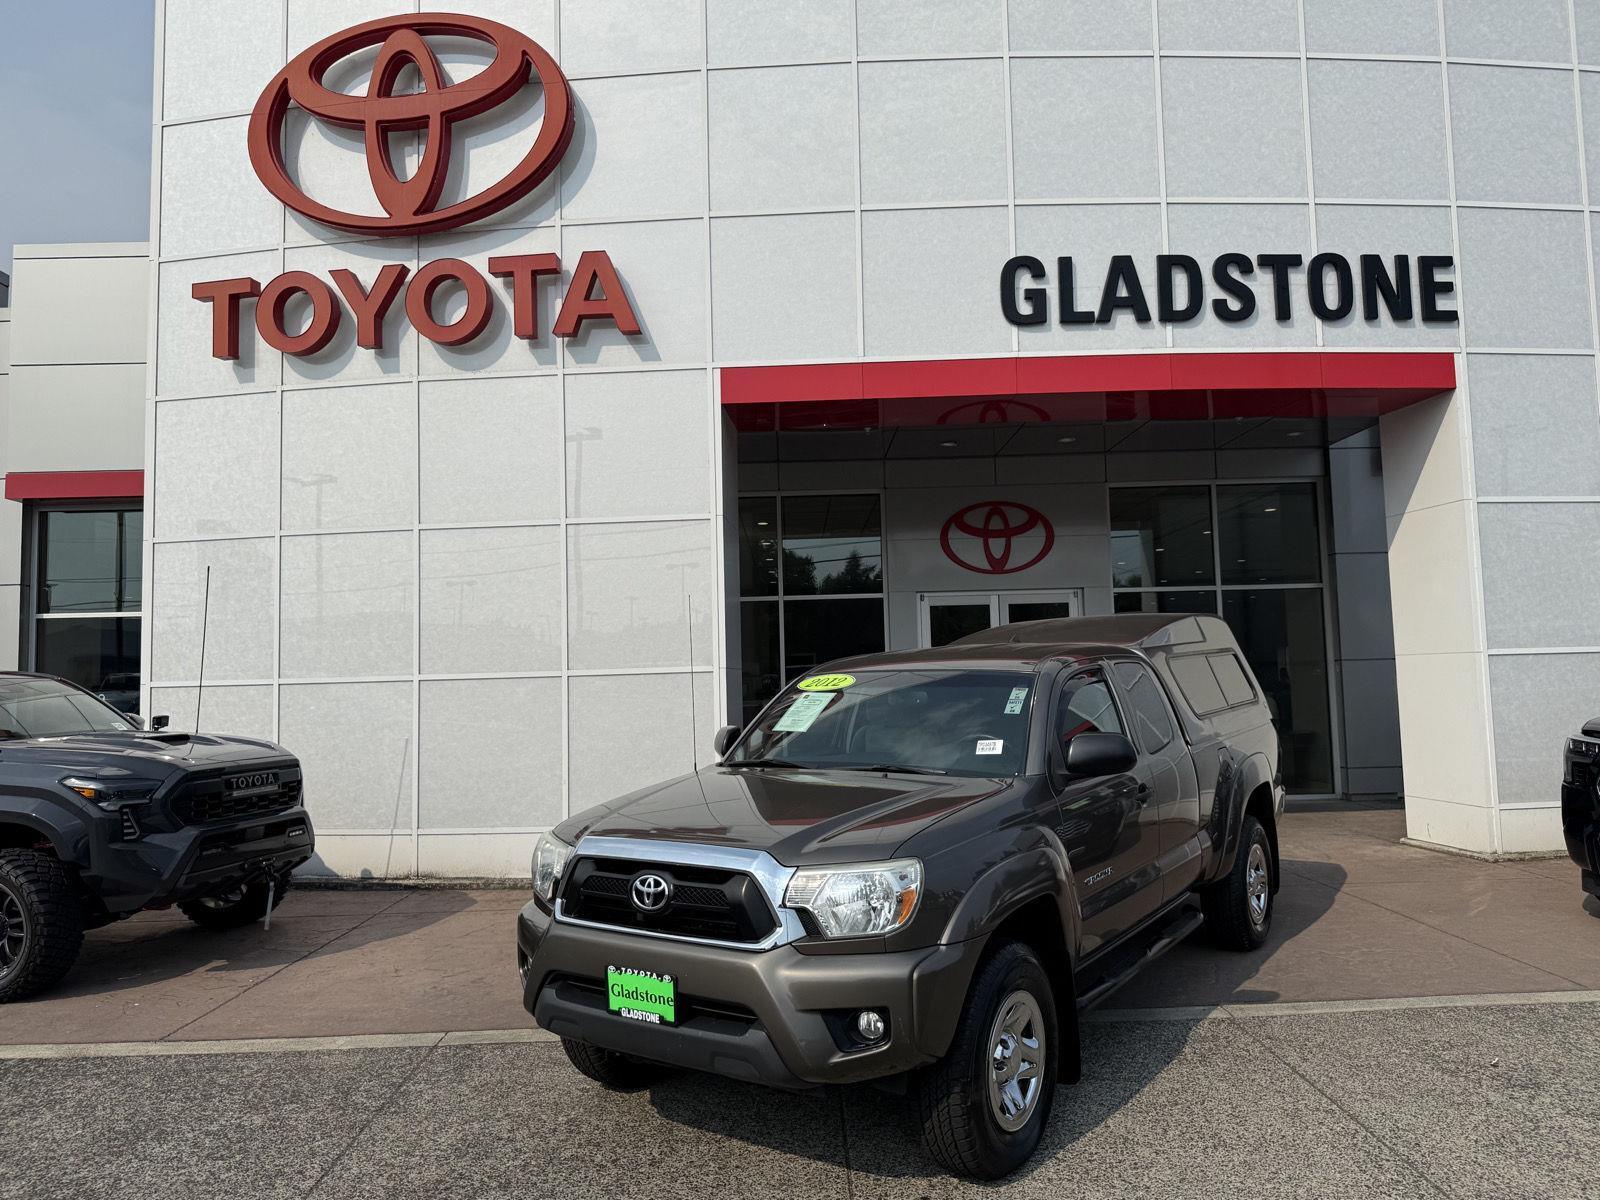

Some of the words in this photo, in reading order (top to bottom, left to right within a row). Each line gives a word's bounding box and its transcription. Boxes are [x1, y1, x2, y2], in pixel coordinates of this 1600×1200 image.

[1000, 252, 1459, 325] GLADSTONE
[191, 250, 642, 361] TOYOTA
[804, 677, 848, 688] 2012
[231, 773, 275, 788] TOYOTA
[621, 967, 658, 980] TOYOTA
[611, 983, 674, 1006] Gladstone
[621, 1007, 660, 1024] GLADSTONE
